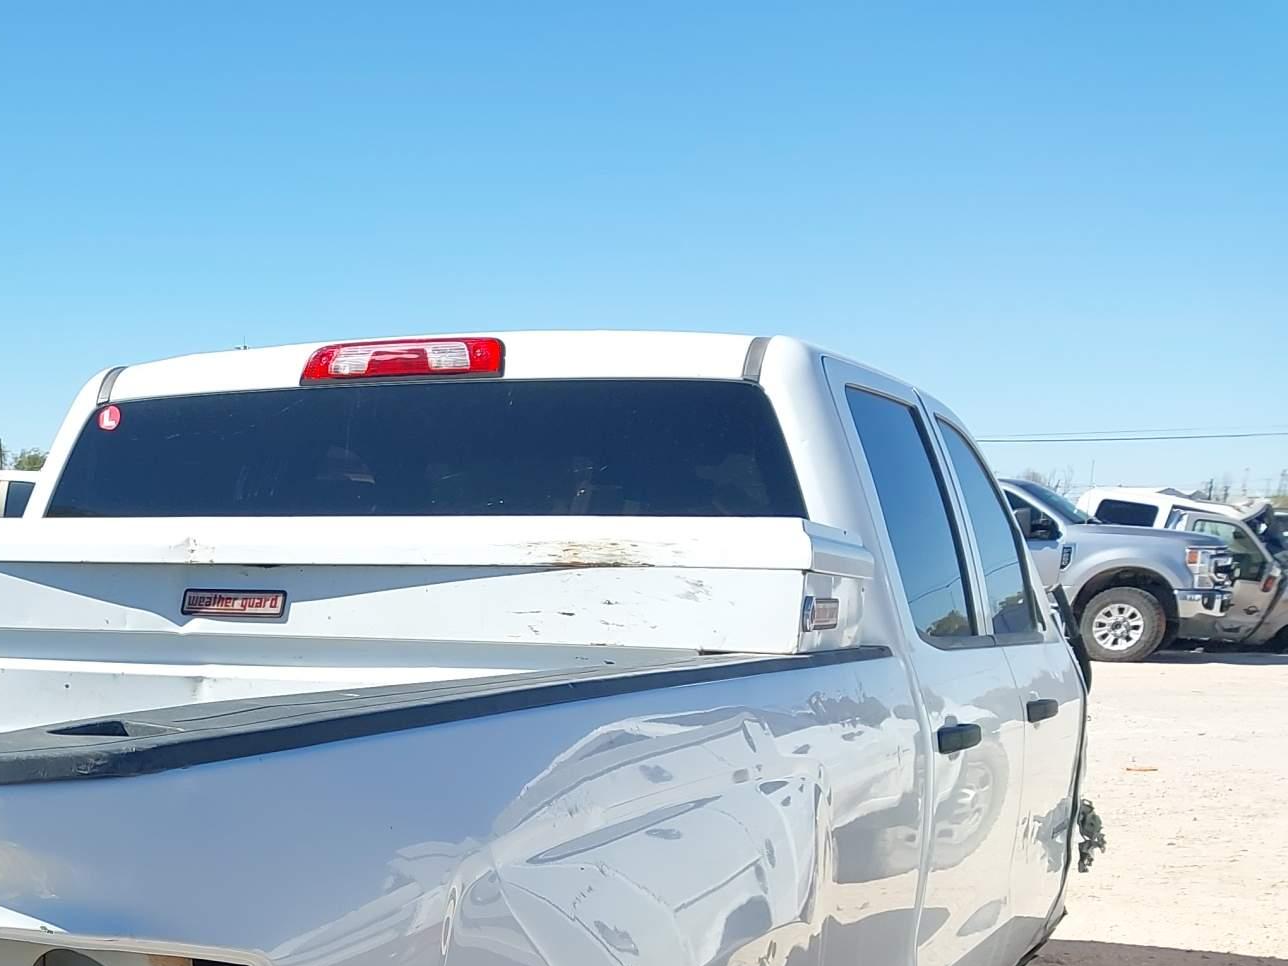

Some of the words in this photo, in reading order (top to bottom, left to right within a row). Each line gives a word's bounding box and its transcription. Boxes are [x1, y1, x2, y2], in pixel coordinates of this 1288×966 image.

[102, 409, 117, 427] L
[187, 593, 239, 608] weather
[240, 594, 280, 611] guard
